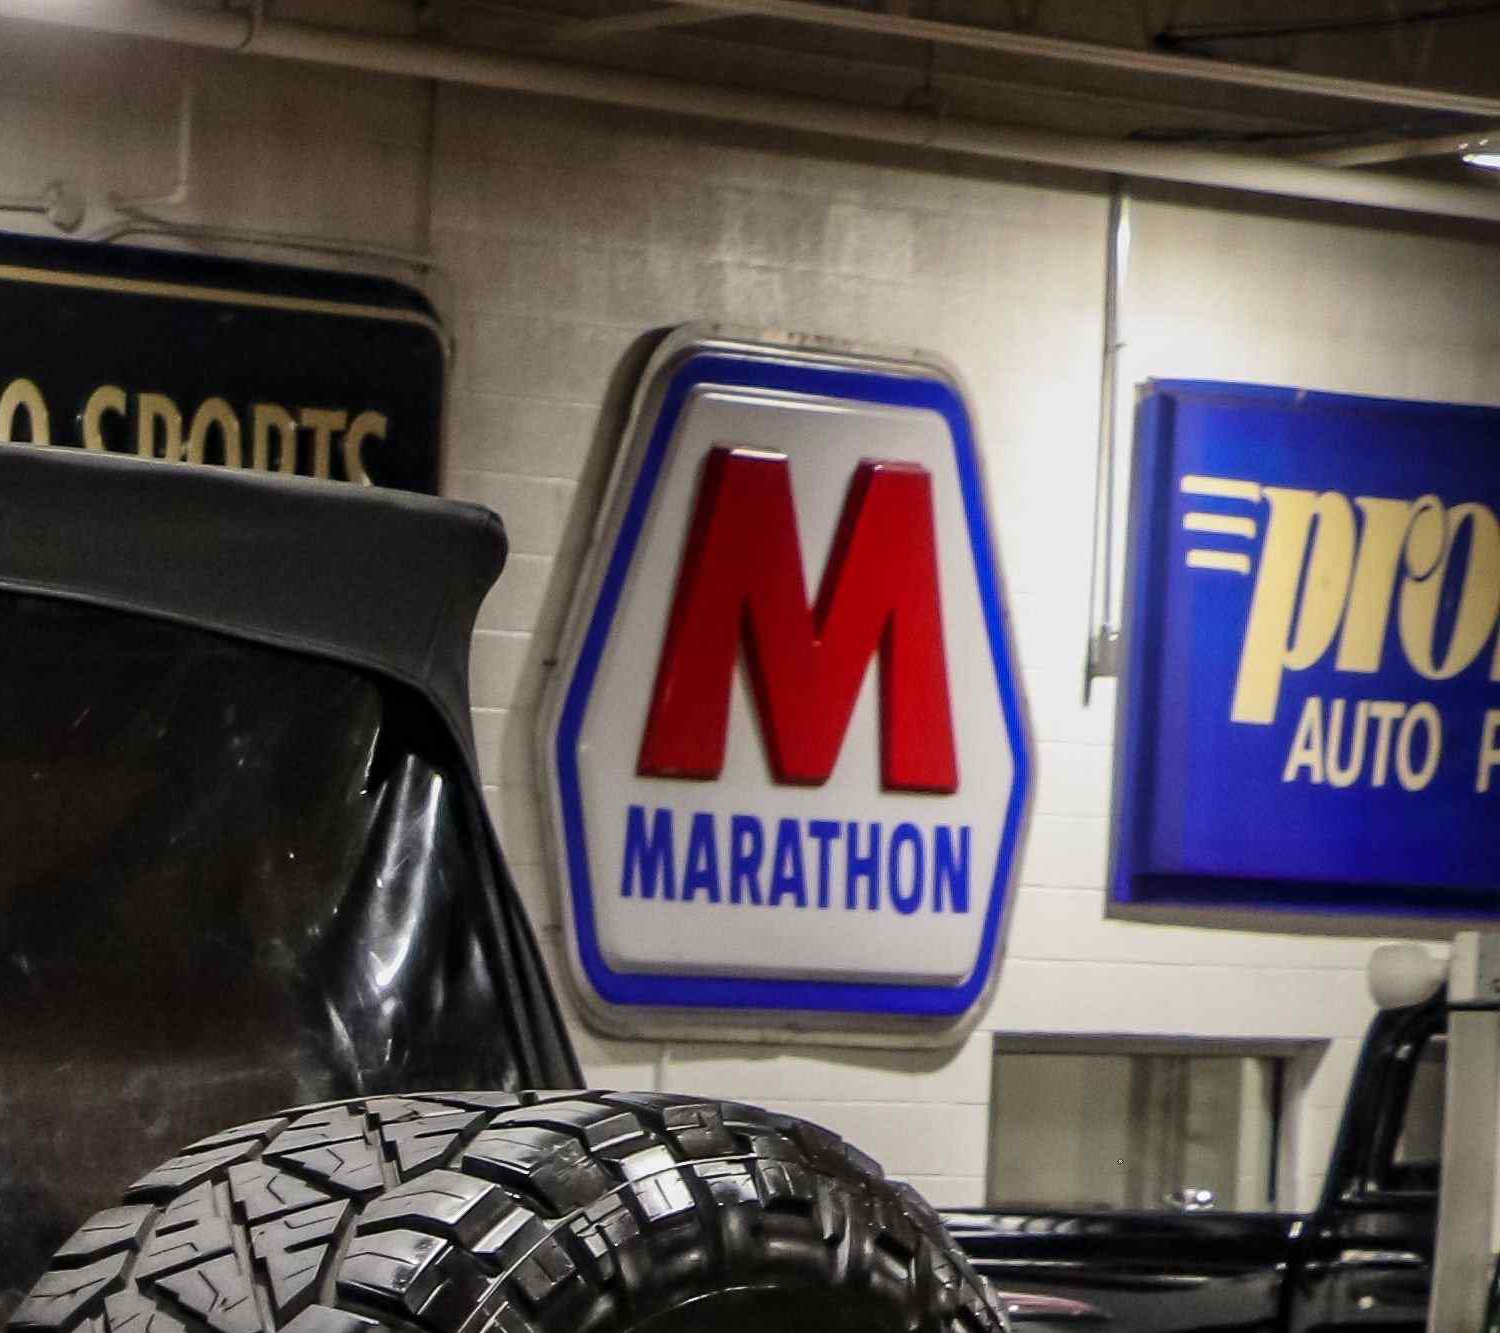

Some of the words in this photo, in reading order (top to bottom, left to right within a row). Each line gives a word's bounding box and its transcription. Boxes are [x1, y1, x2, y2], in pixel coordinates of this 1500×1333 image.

[635, 440, 960, 795] M
[1229, 486, 1500, 726] pro
[1281, 695, 1443, 792] AUTO
[620, 804, 972, 916] MARATHON
